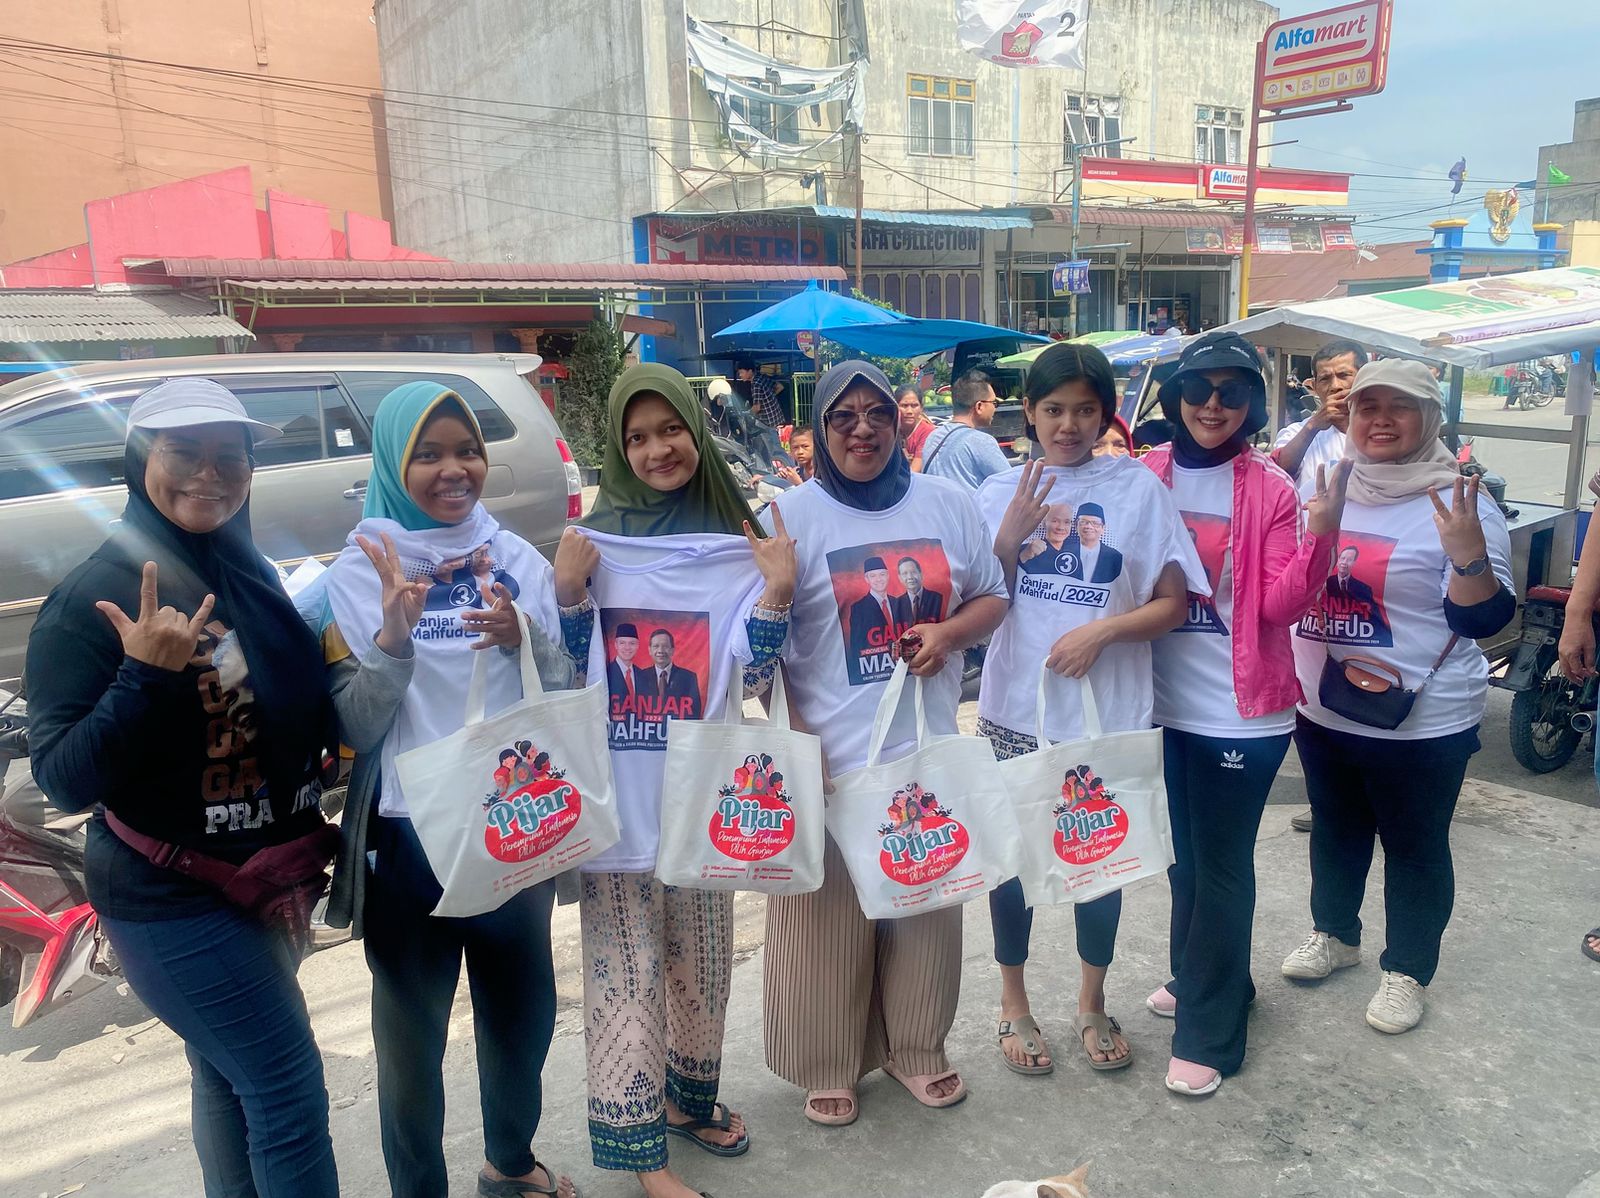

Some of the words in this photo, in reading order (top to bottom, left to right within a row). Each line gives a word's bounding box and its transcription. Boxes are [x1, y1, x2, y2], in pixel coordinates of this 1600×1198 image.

[1057, 11, 1077, 38] 2
[1274, 14, 1368, 52] Alfamart
[1212, 170, 1248, 185] Alfama
[704, 234, 818, 259] METRO
[892, 228, 977, 251] COLLECTION
[1060, 554, 1073, 573] 3
[1019, 585, 1059, 601] Mahfud
[1021, 575, 1054, 590] Ganjar
[456, 586, 470, 605] 3
[1066, 588, 1104, 604] 2024
[419, 615, 456, 630] anjar
[1302, 612, 1374, 637] MAHFUD
[487, 785, 573, 839] Pijar
[718, 796, 792, 837] Pijar
[1057, 806, 1120, 842] Pijar
[500, 831, 544, 855] Perempuan
[544, 813, 578, 835] Indonesia
[518, 842, 536, 860] Pilih
[537, 832, 564, 849] Ganjar
[882, 822, 959, 863] Pijar
[893, 860, 932, 877] Perempuan
[932, 847, 965, 865] Indonesia
[909, 870, 926, 884] Pilih
[927, 863, 953, 877] Ganjar
